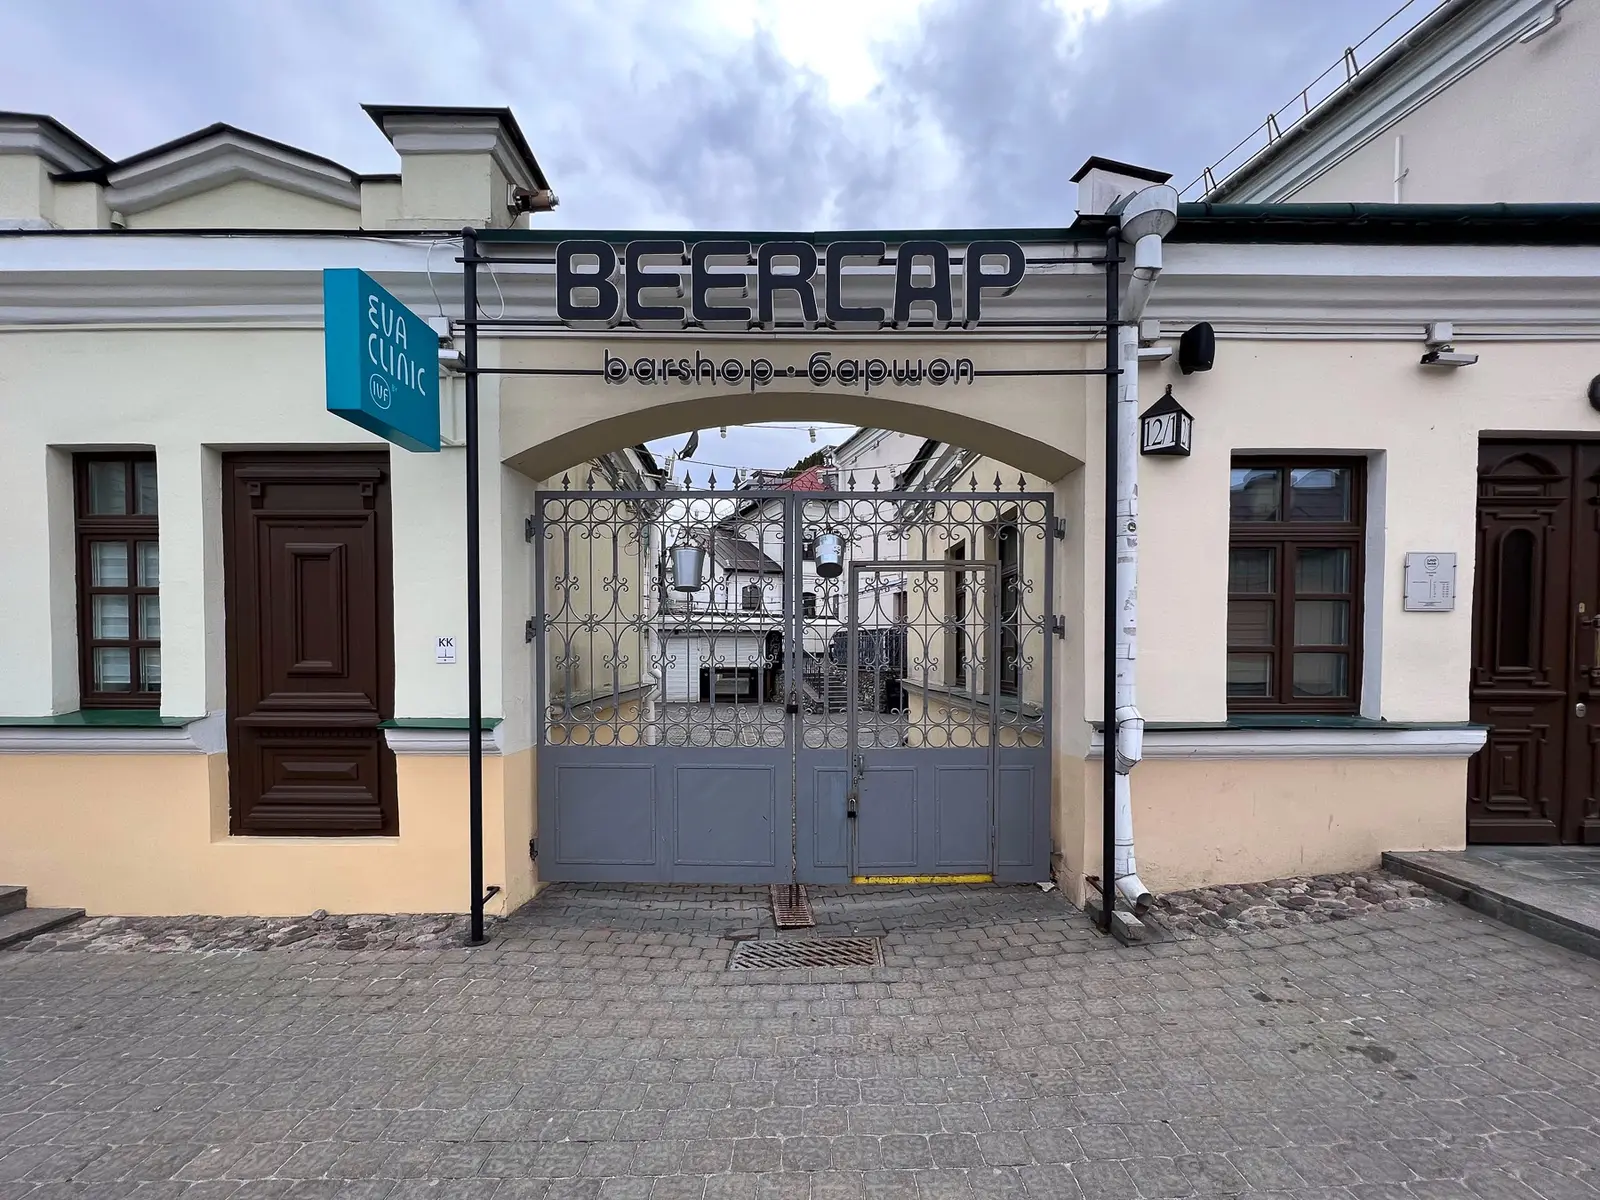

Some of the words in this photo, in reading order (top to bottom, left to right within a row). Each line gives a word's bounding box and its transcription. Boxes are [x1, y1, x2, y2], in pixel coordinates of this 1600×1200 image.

[555, 239, 1027, 329] BEERCAP
[368, 294, 407, 350] EVA
[368, 332, 426, 397] CLINIC
[603, 348, 775, 394] barshop
[807, 351, 975, 395] баршоп
[1143, 414, 1176, 448] 12/1
